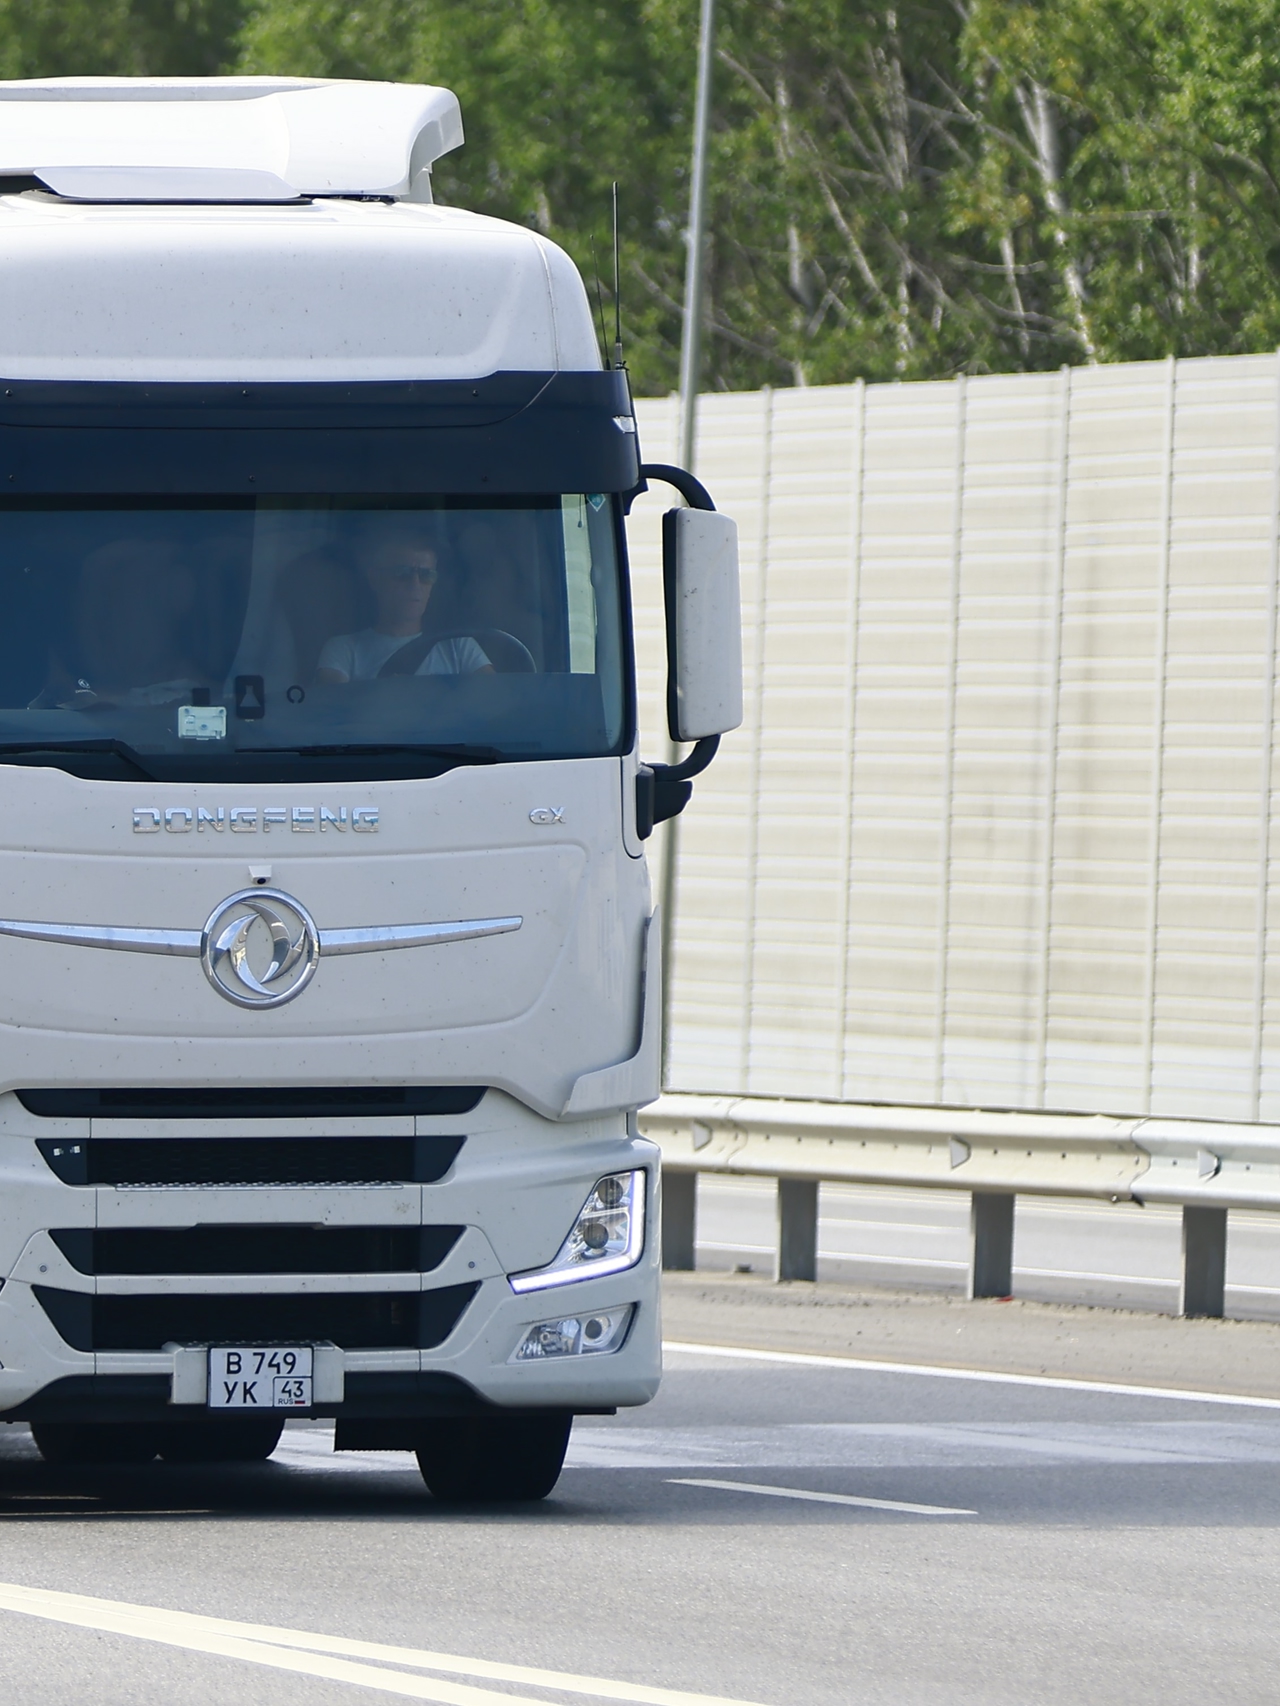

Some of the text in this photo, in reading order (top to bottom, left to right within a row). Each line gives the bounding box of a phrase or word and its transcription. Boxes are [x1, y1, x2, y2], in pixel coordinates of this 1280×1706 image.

[133, 807, 379, 833] DONGFENG
[528, 807, 567, 825] GX
[226, 1352, 297, 1375] В 749
[223, 1381, 258, 1404] УК
[281, 1381, 304, 1398] 43
